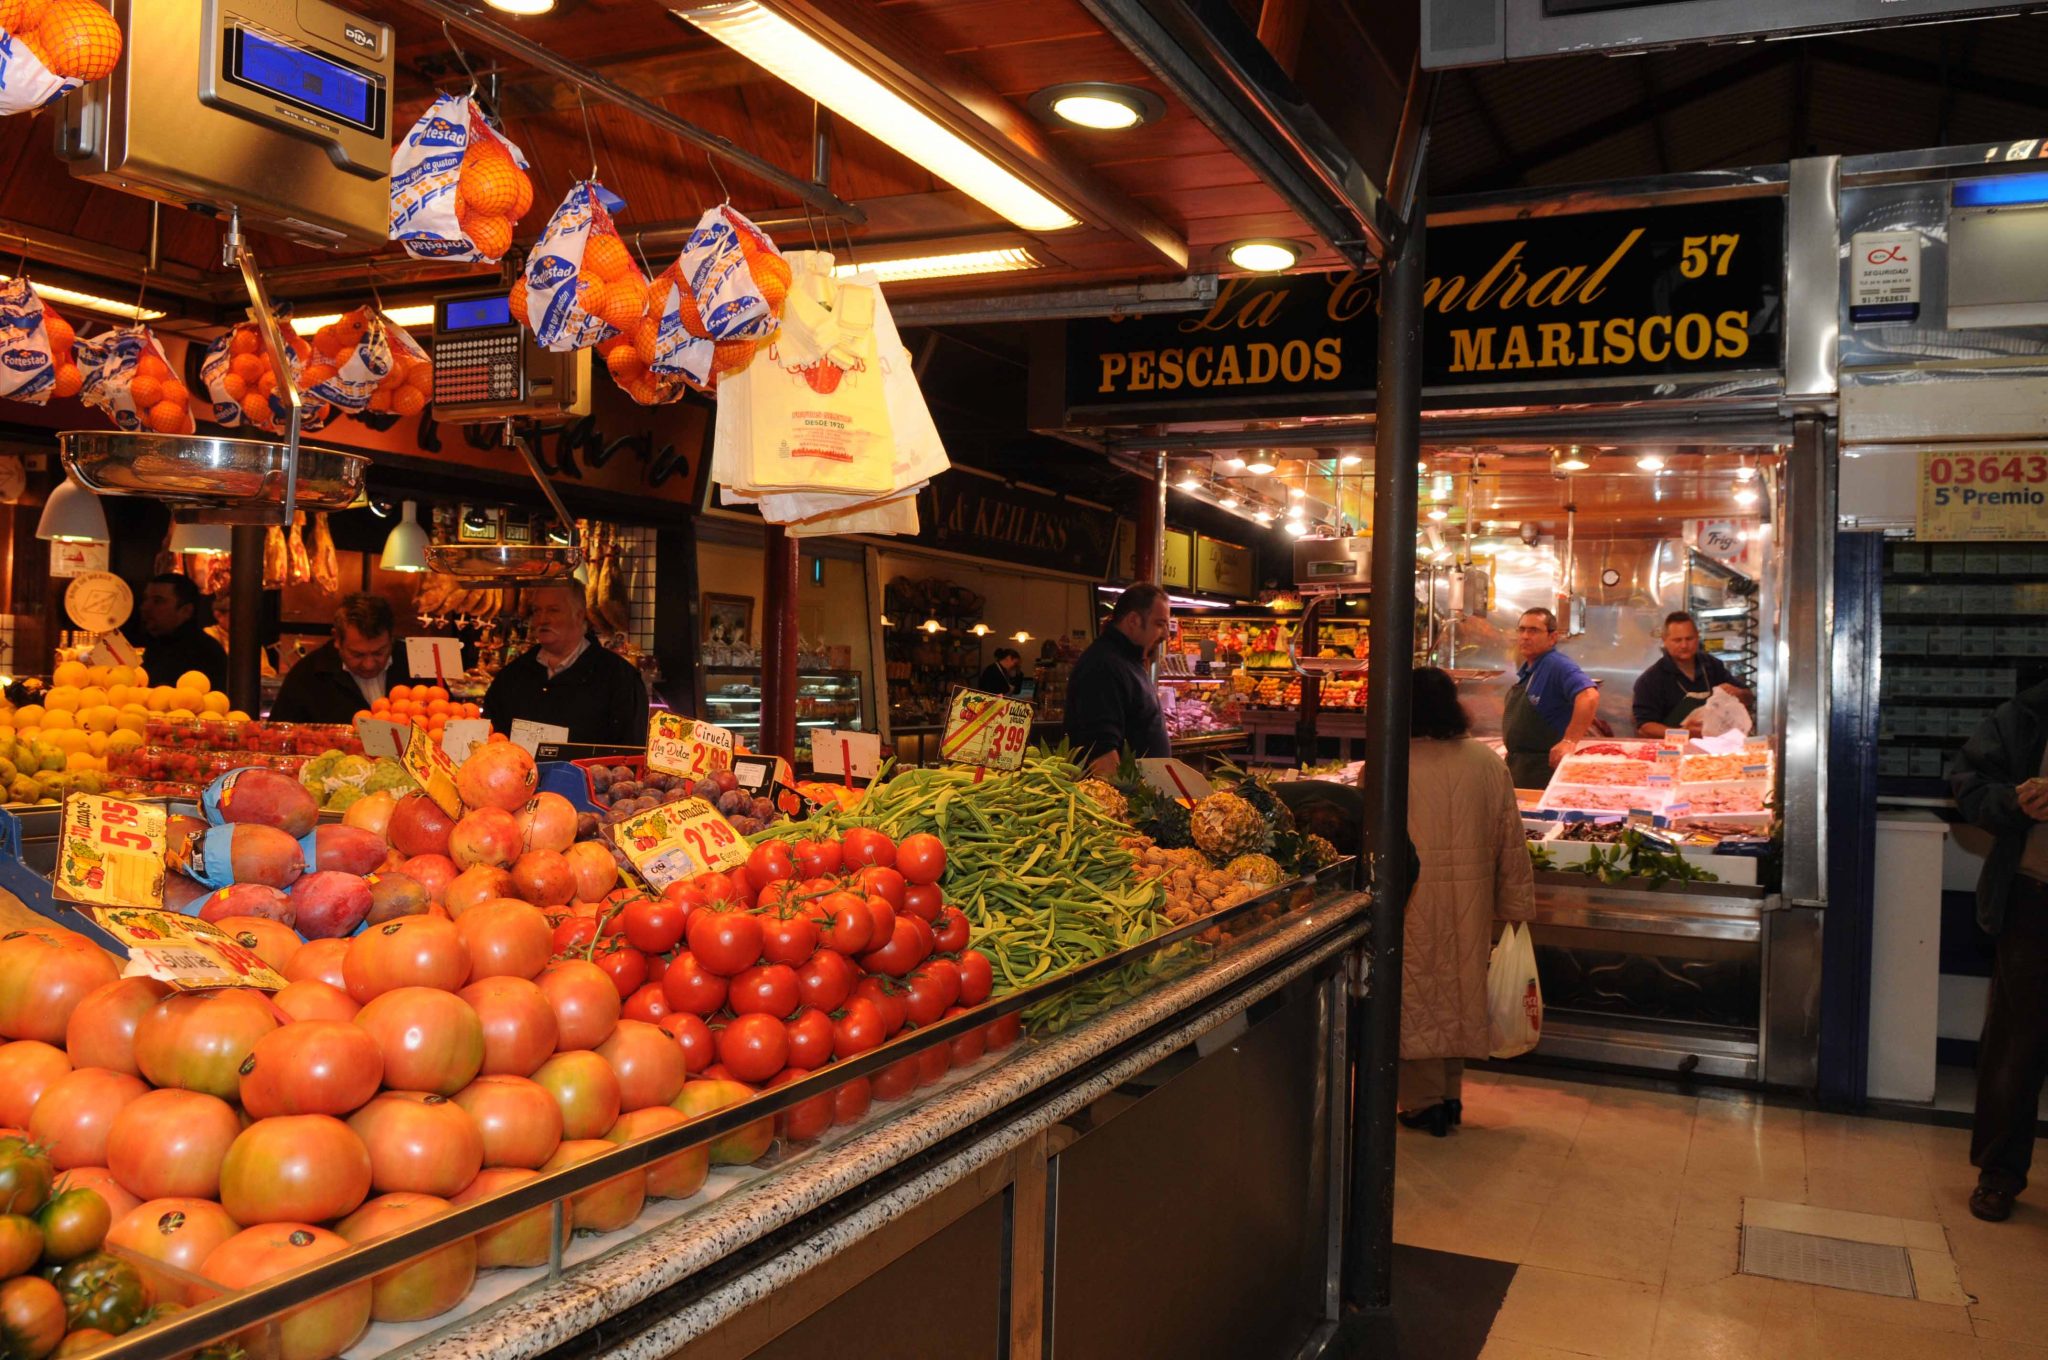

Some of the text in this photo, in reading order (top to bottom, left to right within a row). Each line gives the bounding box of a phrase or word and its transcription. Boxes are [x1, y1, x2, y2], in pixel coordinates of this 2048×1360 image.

[345, 28, 375, 47] DINA
[1326, 228, 1646, 322] Cntral
[1680, 234, 1740, 279] 57
[4, 355, 46, 366] Fontestad
[1098, 310, 1749, 393] PESCADOS MARISCOS
[805, 419, 845, 429] DESDE 1920
[1930, 456, 2048, 485] 03643
[1963, 487, 2045, 506] Premio
[695, 723, 730, 748] Ciruela
[70, 801, 93, 839] Mangos
[664, 802, 710, 826] Tomates
